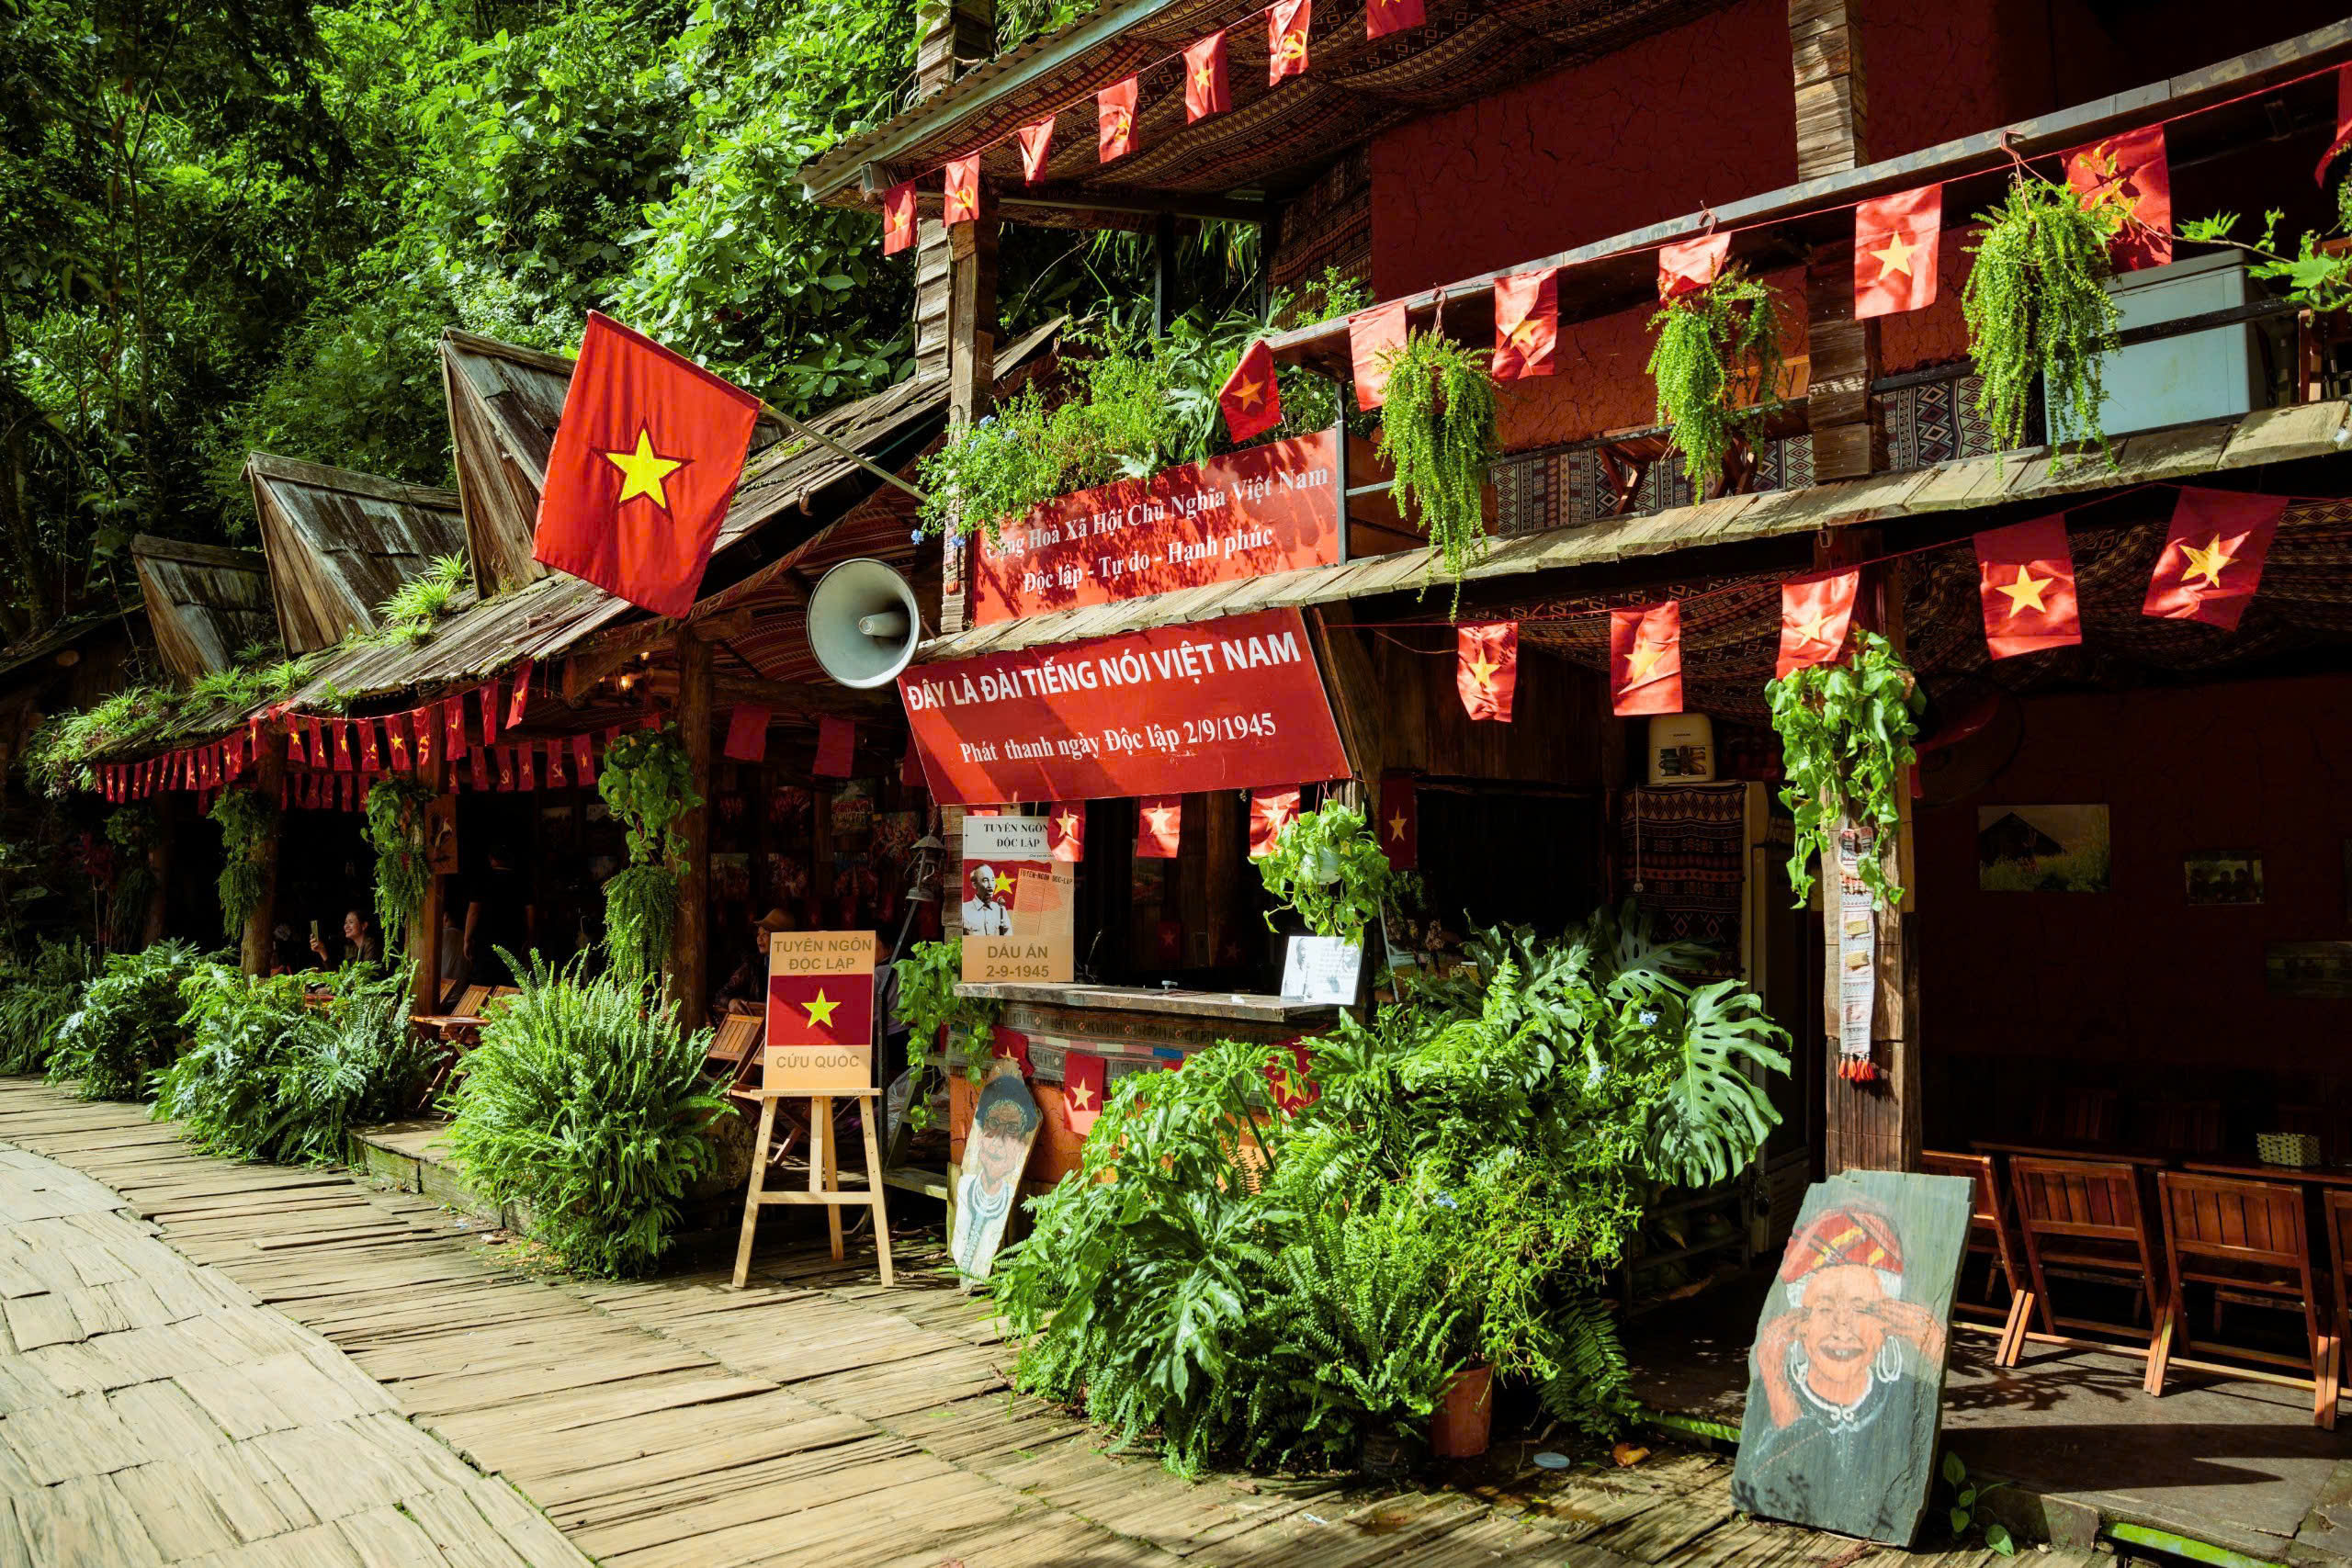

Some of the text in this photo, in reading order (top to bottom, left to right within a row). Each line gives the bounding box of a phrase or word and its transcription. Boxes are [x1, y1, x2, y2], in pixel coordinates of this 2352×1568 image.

[1029, 524, 1059, 549] Hoà
[1065, 517, 1087, 542] Xã
[1092, 509, 1122, 536] Hội
[1127, 500, 1165, 526] Chủ
[1170, 488, 1226, 520] Nghĩa
[1231, 476, 1272, 504] Việt
[1278, 467, 1329, 494] Nam
[1023, 570, 1054, 594] Độc
[1057, 564, 1083, 590] lập
[1098, 556, 1125, 581] Tự
[1128, 551, 1150, 572] do
[1168, 535, 1218, 567] Hạnh
[1225, 525, 1273, 559] phúc
[906, 631, 1302, 711] ĐÂY LÀ ĐÀI TIẾNG NÓI VIỆT NAM
[959, 712, 1276, 763] Phát thanh ngày Độc lập 2/9/1945
[997, 837, 1017, 849] ĐỘC
[774, 937, 872, 953] TUYÊN NGÔN
[788, 955, 855, 973] ĐỘC LẬP
[986, 964, 1049, 978] 2-9-1945
[776, 1053, 809, 1068] CỨU
